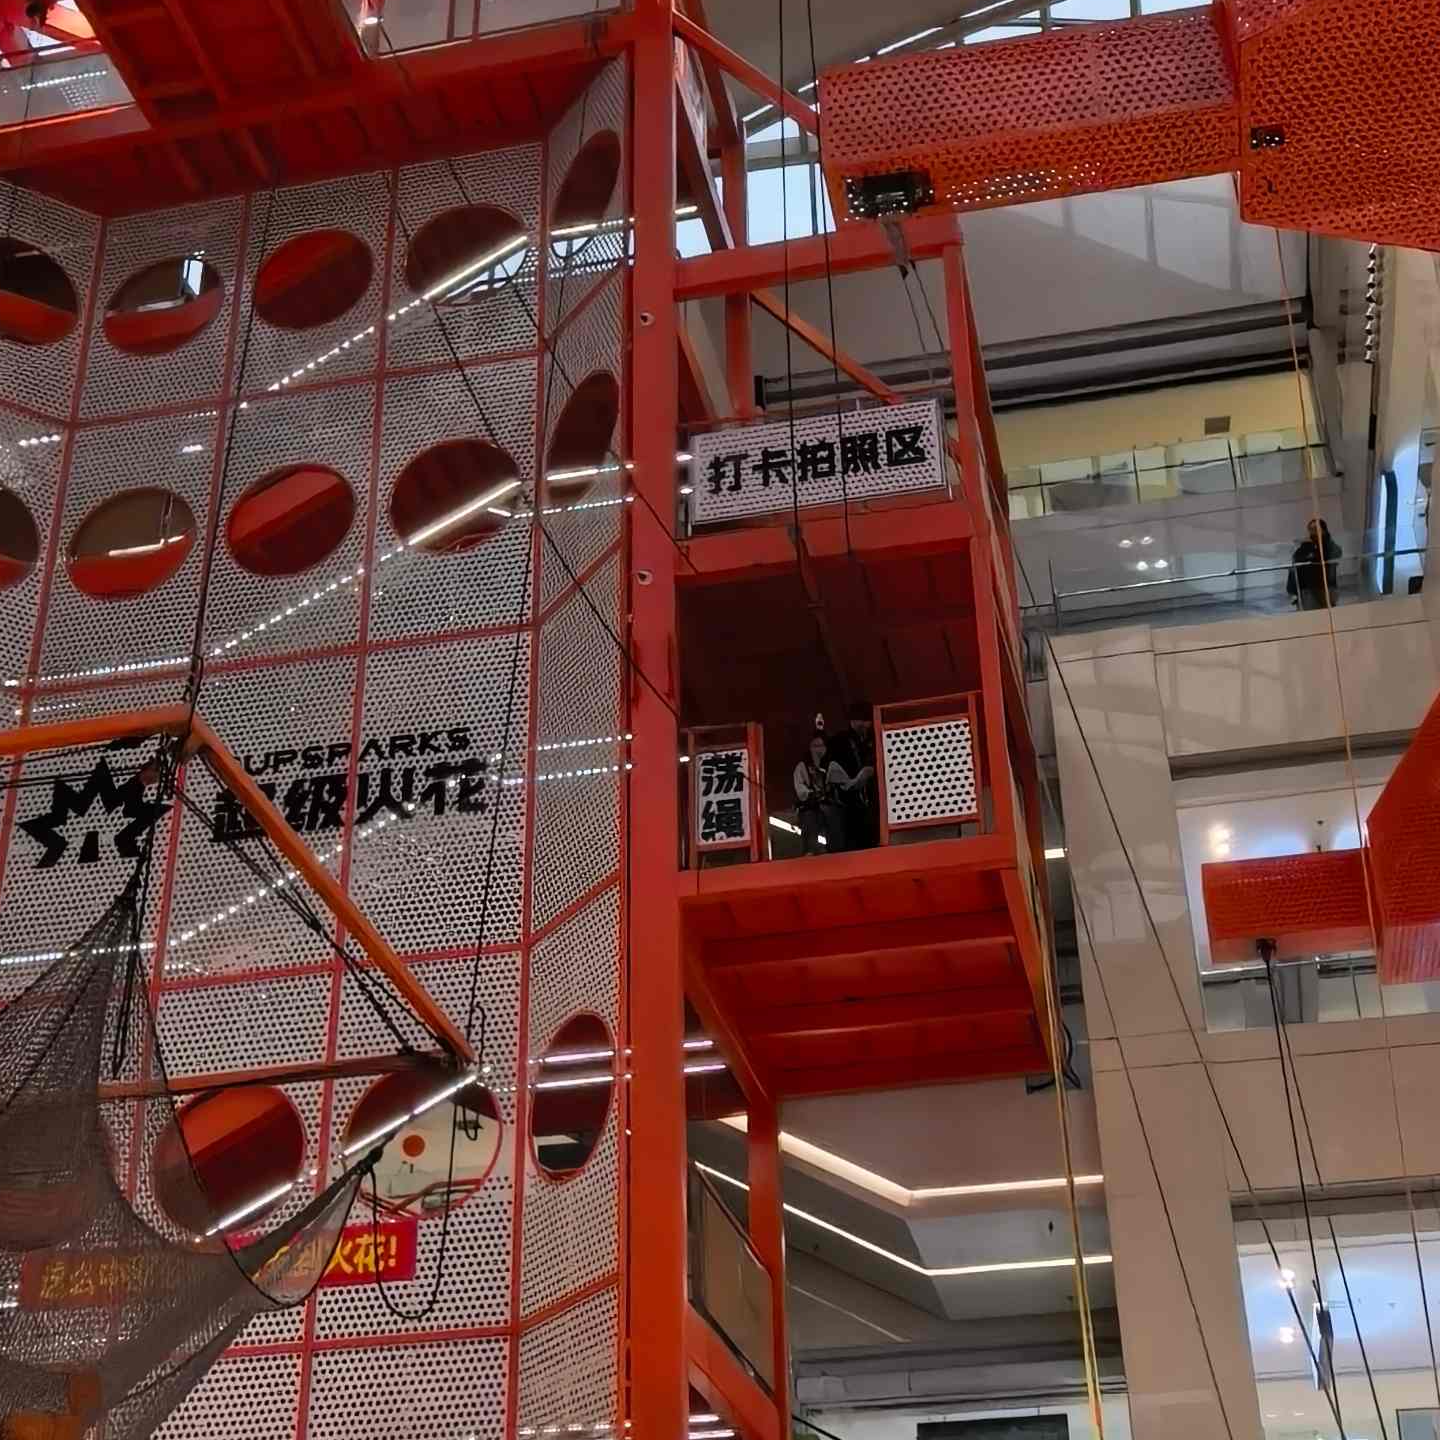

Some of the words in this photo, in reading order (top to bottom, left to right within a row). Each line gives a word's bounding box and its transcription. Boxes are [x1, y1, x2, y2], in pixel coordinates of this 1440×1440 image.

[707, 424, 927, 494] 打卡拍照区
[242, 726, 472, 777] UPSPARKS
